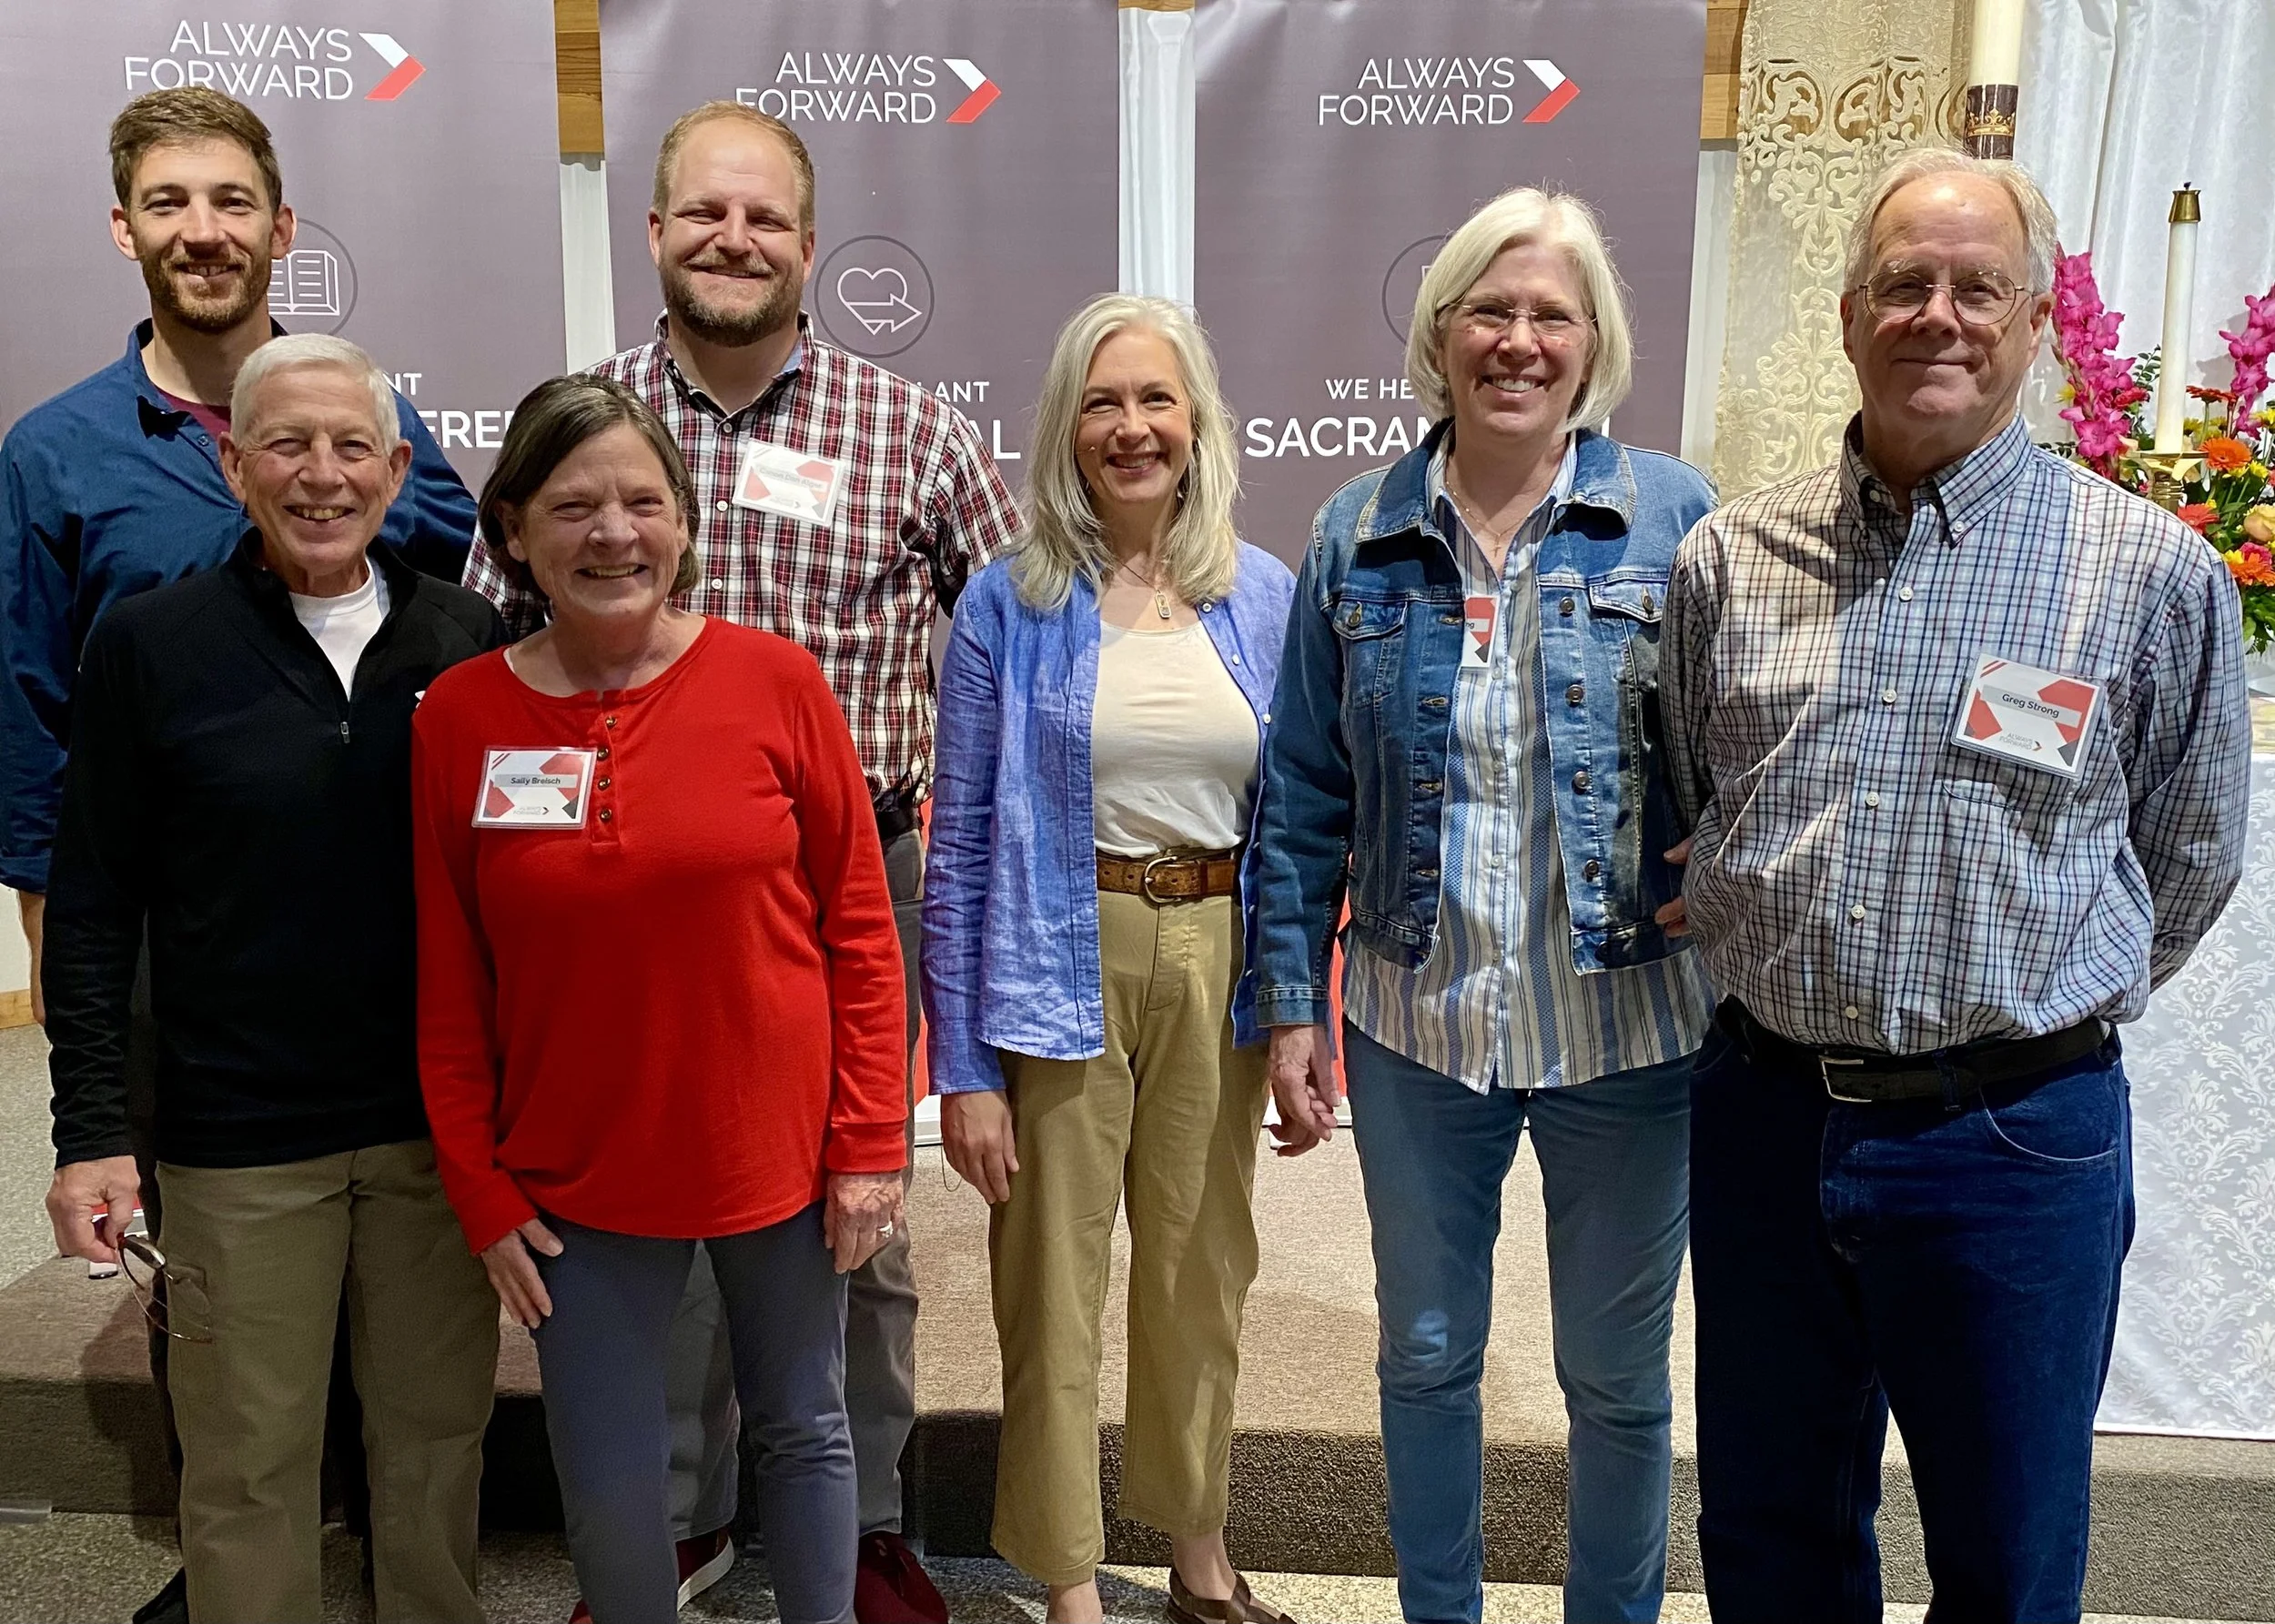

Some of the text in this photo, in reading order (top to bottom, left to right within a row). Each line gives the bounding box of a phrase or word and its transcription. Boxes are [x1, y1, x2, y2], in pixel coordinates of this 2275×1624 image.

[169, 20, 352, 62] ALWAYS
[124, 56, 353, 100] FORWARD
[775, 51, 936, 86] ALWAYS
[1357, 57, 1515, 90] ALWAYS
[735, 88, 936, 124] FORWARD
[1318, 95, 1514, 126] FORWARD
[1325, 378, 1369, 399] WE
[2002, 693, 2059, 718] Greg Strong
[511, 777, 530, 786] Sally
